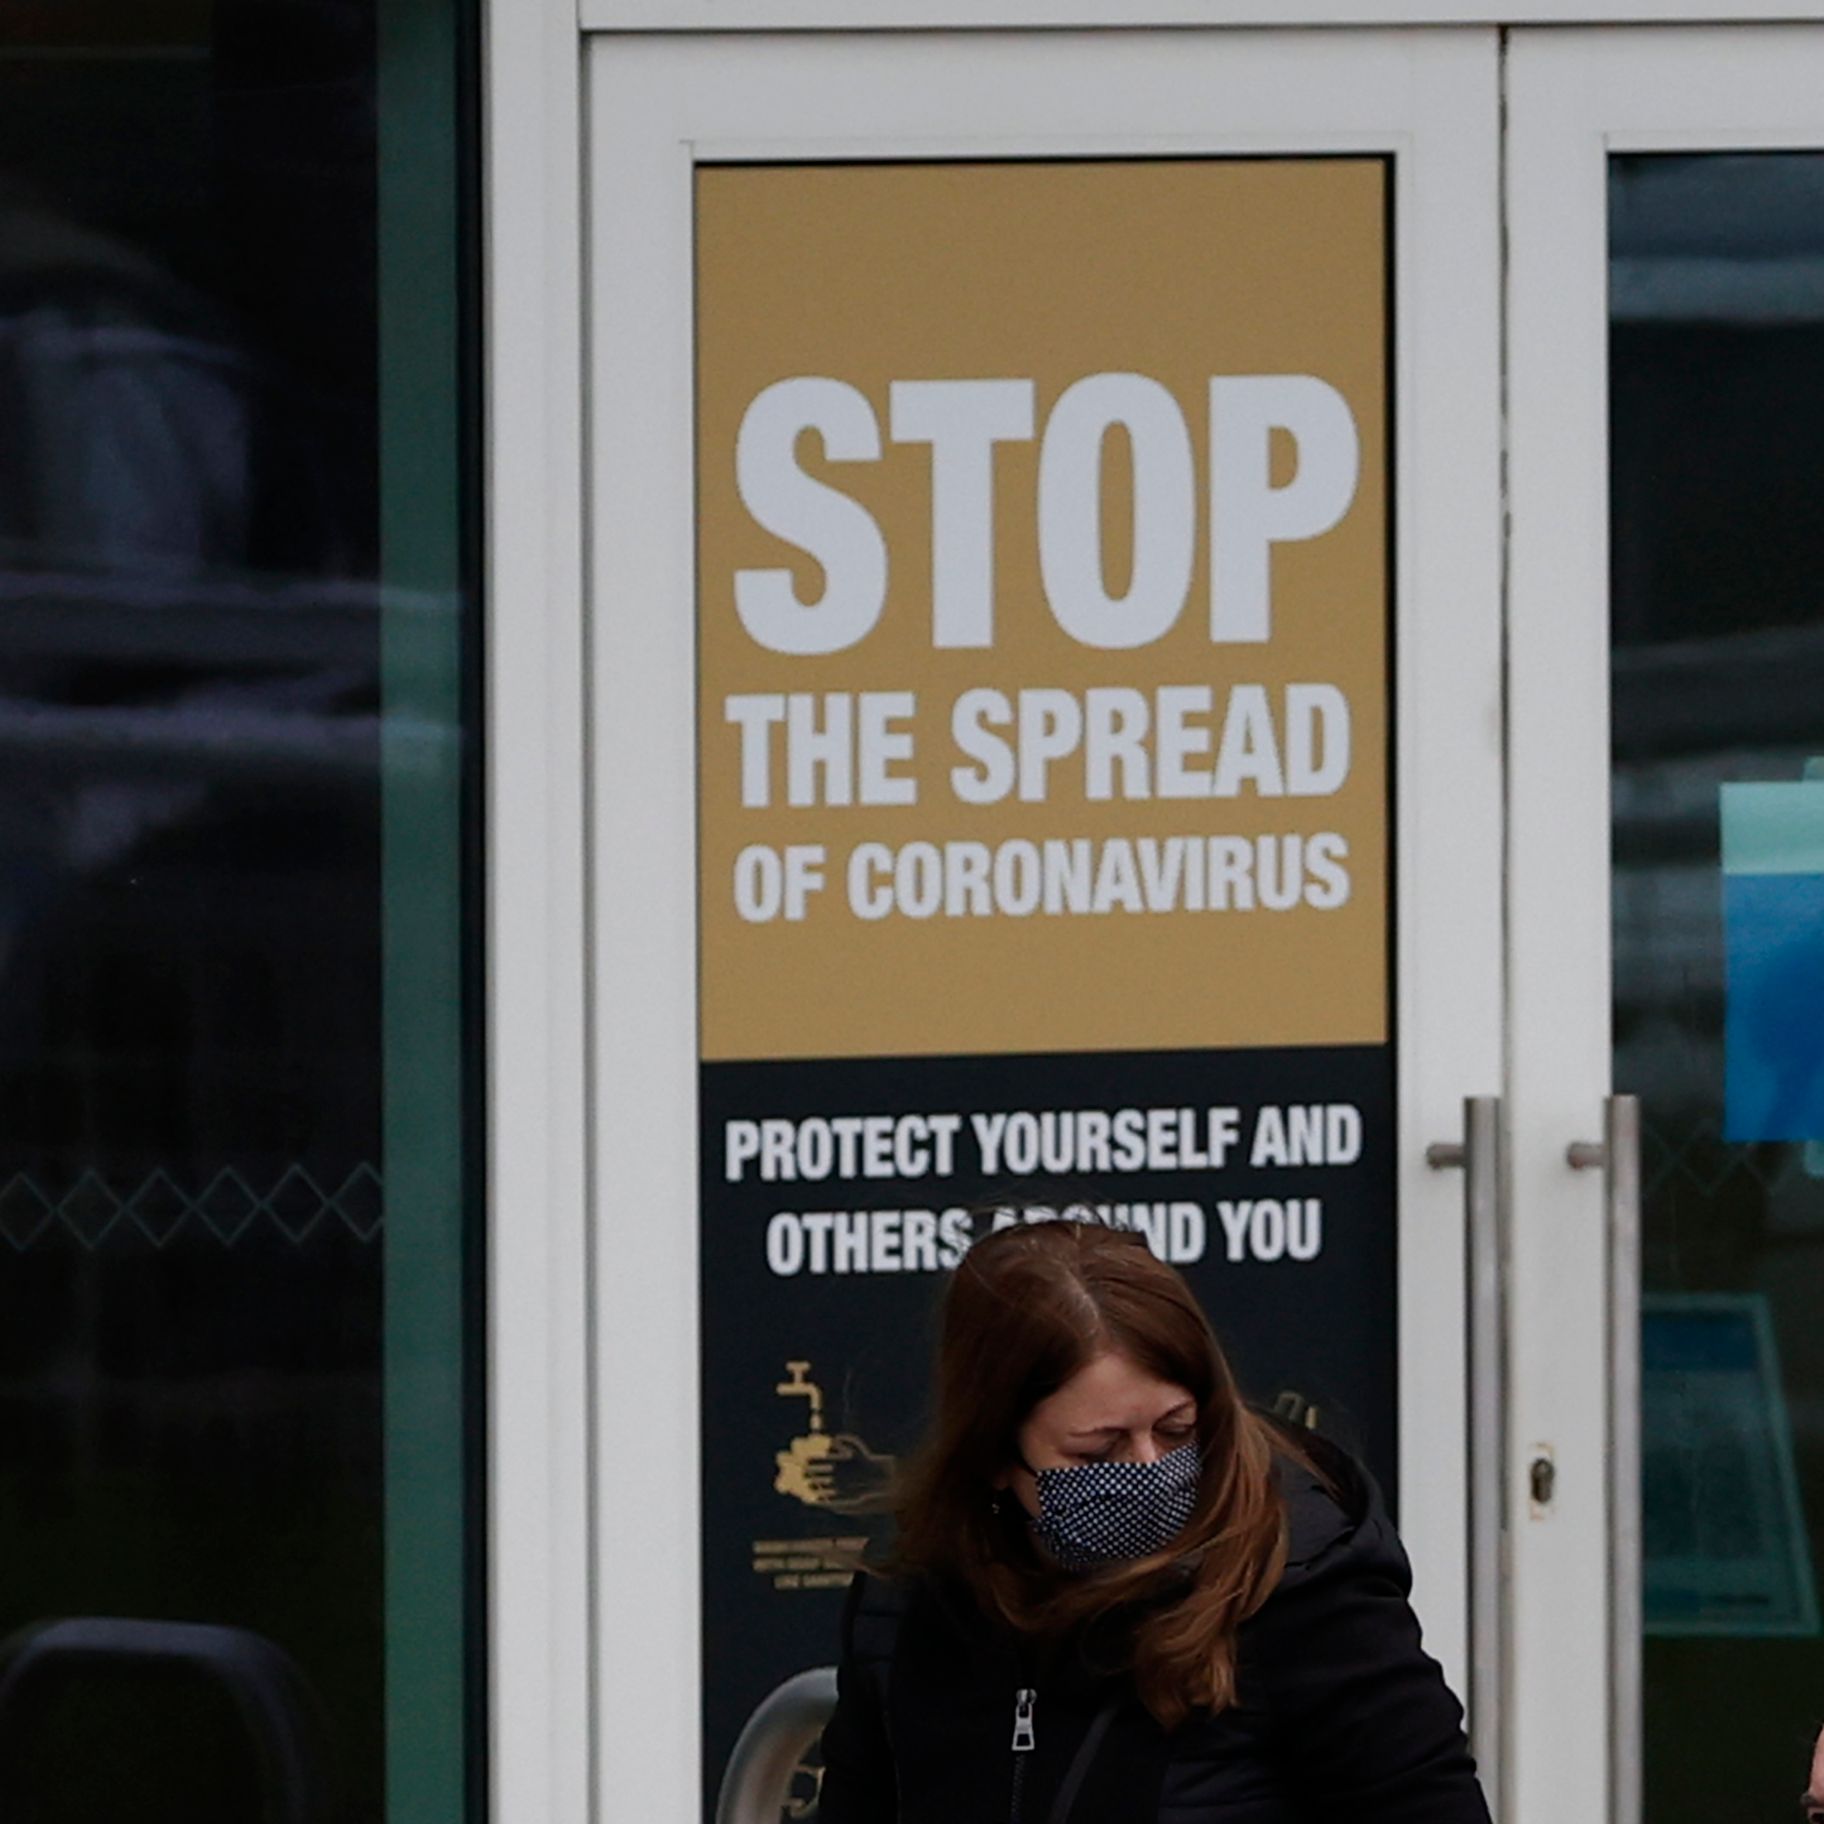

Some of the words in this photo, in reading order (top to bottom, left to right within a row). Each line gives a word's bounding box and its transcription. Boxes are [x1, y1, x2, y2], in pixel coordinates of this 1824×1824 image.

[733, 372, 1360, 656] STOP
[724, 692, 916, 810] THE
[950, 682, 1353, 807] SPREAD
[732, 843, 825, 924] OF
[847, 833, 1351, 921] CORONAVIRUS
[725, 1114, 962, 1183] PROTECT
[971, 1106, 1240, 1175] YOURSELF
[1250, 1103, 1364, 1168] AND
[766, 1207, 974, 1277] OTHERS
[1216, 1198, 1323, 1263] YOU
